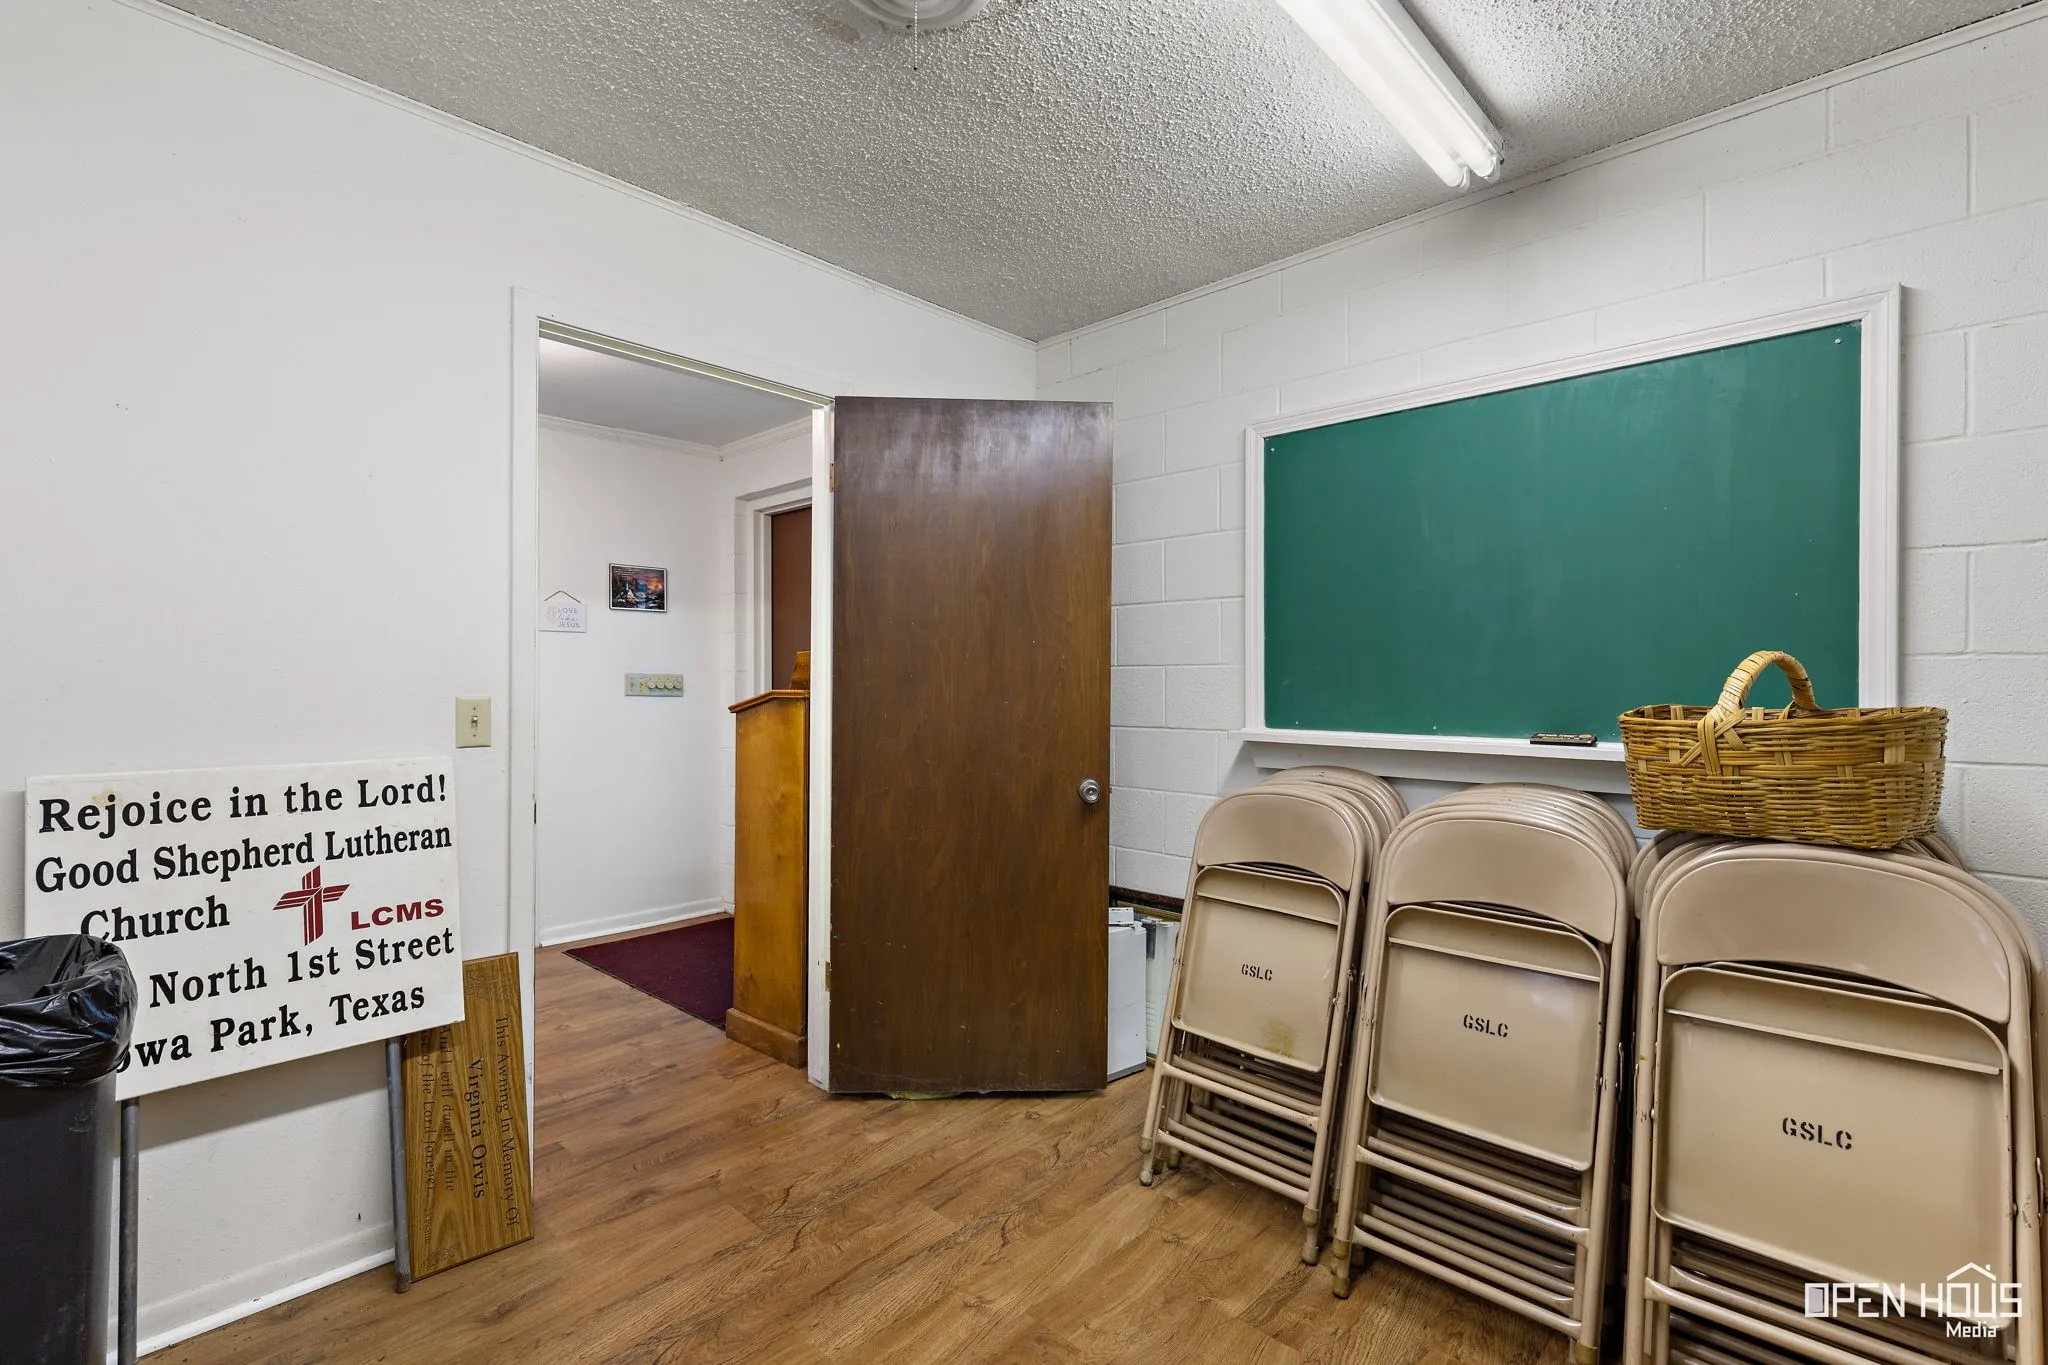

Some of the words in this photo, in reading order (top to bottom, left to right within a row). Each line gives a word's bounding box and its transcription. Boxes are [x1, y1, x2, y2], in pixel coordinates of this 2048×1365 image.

[38, 790, 212, 840] Rejoice
[229, 786, 269, 819] in
[283, 781, 343, 814] the
[357, 773, 446, 808] Lord!
[35, 848, 140, 893] Good
[153, 831, 315, 882] Shepherd
[324, 825, 452, 861] Lutheran
[80, 894, 230, 942] Church
[351, 898, 444, 931] LCMS
[149, 956, 268, 1009] North
[287, 946, 341, 983] 1st
[355, 927, 455, 971] Street
[1241, 963, 1273, 981] GSLC
[116, 1034, 193, 1074] wa
[210, 1004, 314, 1053] Park,
[328, 986, 425, 1026] Texas
[495, 1016, 509, 1048] This
[1463, 1014, 1508, 1038] GSLC
[422, 1074, 435, 1095] the
[440, 1071, 454, 1098] will
[464, 1056, 485, 1139] Virginia
[495, 1054, 512, 1114] Awning
[423, 1101, 437, 1134] Lord
[442, 1104, 456, 1142] dwell
[501, 1117, 513, 1133] In
[1782, 1117, 1853, 1150] GSLC
[445, 1170, 457, 1192] the
[471, 1144, 488, 1199] Orvis
[500, 1136, 515, 1201] Memory
[505, 1207, 519, 1228] Of
